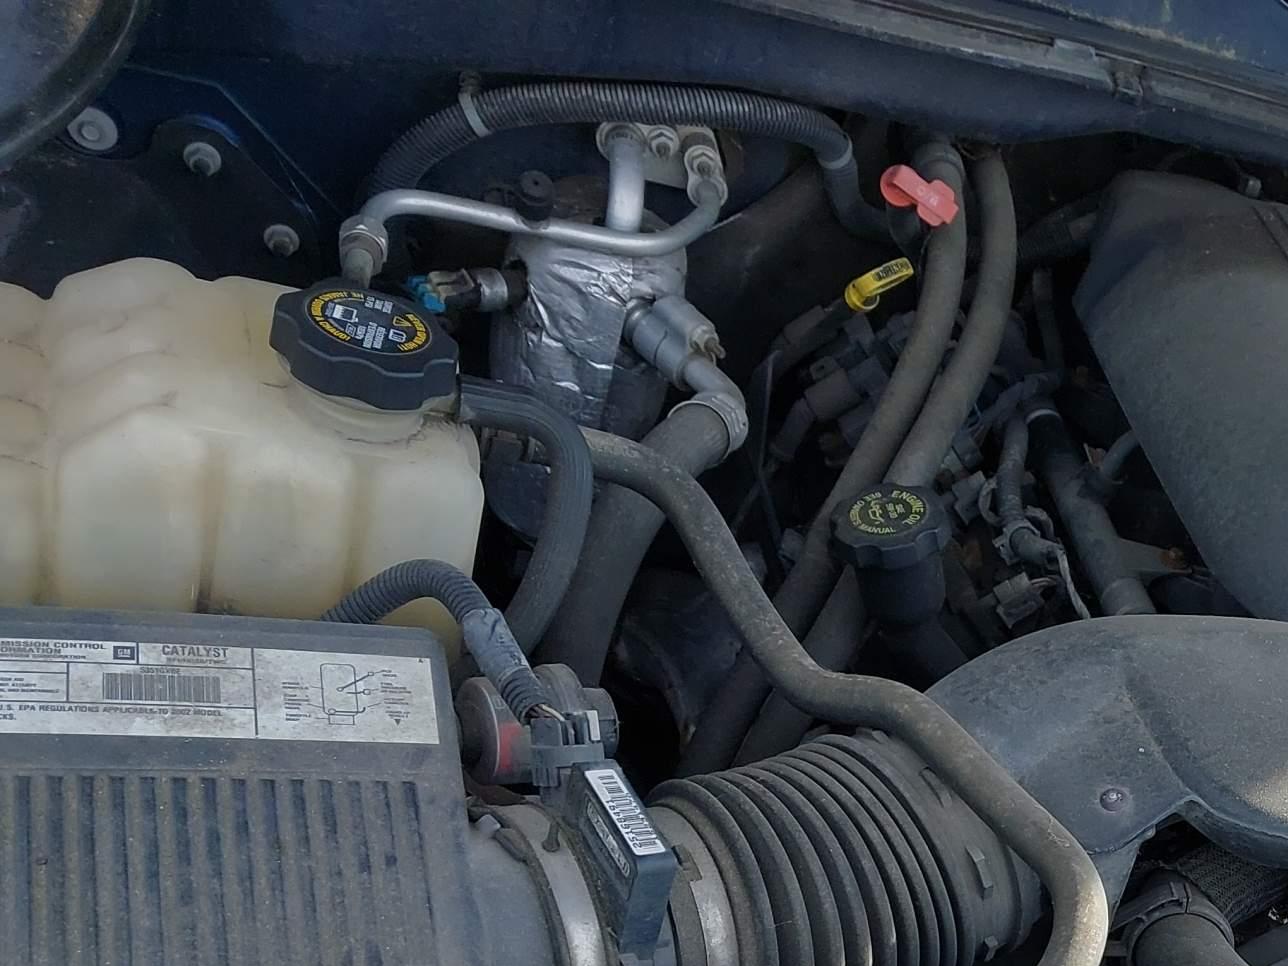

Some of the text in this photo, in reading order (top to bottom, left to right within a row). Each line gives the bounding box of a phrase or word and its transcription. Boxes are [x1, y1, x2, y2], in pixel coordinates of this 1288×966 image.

[891, 490, 924, 513] ENGINE
[902, 514, 920, 525] OIL
[858, 523, 897, 534] MANUAL
[53, 641, 108, 650] CONTROL
[162, 645, 229, 658] CATALYST
[18, 704, 36, 712] EPA
[38, 704, 100, 714] REGULATIONS
